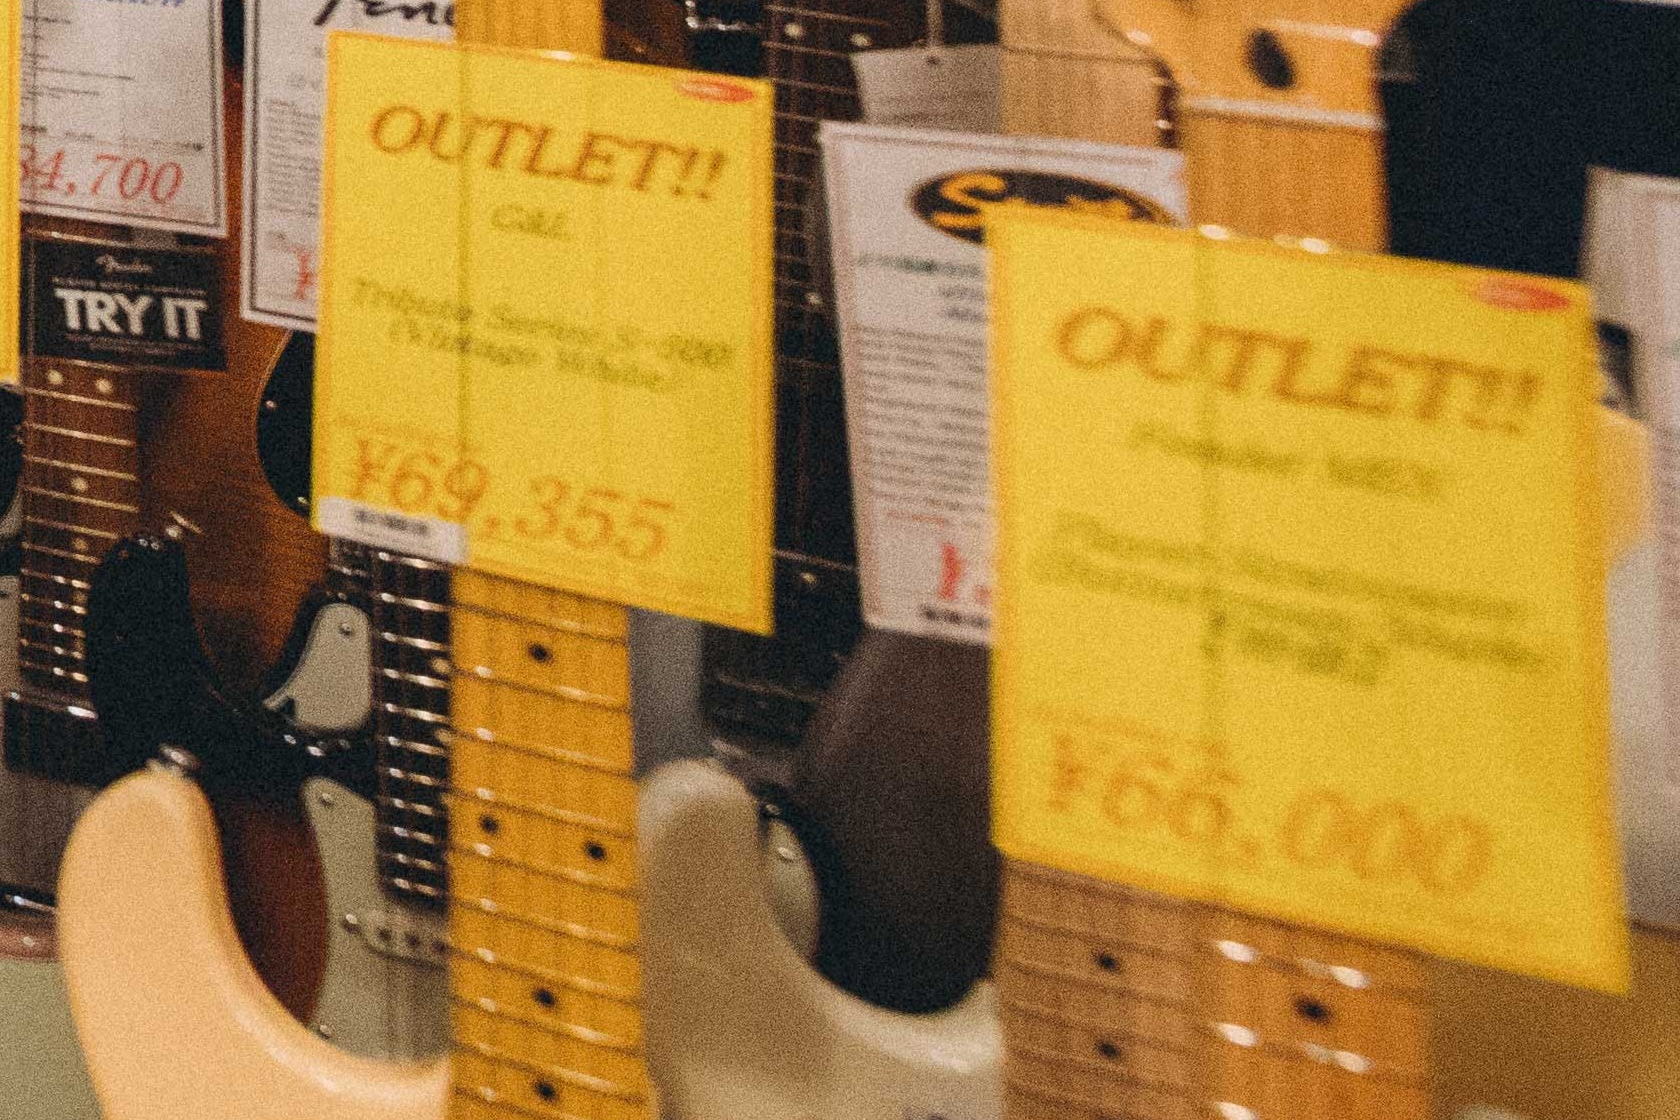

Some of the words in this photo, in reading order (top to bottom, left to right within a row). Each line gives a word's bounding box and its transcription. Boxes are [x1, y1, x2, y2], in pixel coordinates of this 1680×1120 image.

[368, 105, 730, 200] OUTLET!!
[54, 288, 148, 337] TRY
[159, 299, 208, 341] IT
[1057, 304, 1547, 434] OUTLET!!
[351, 438, 677, 566] ¥69,355
